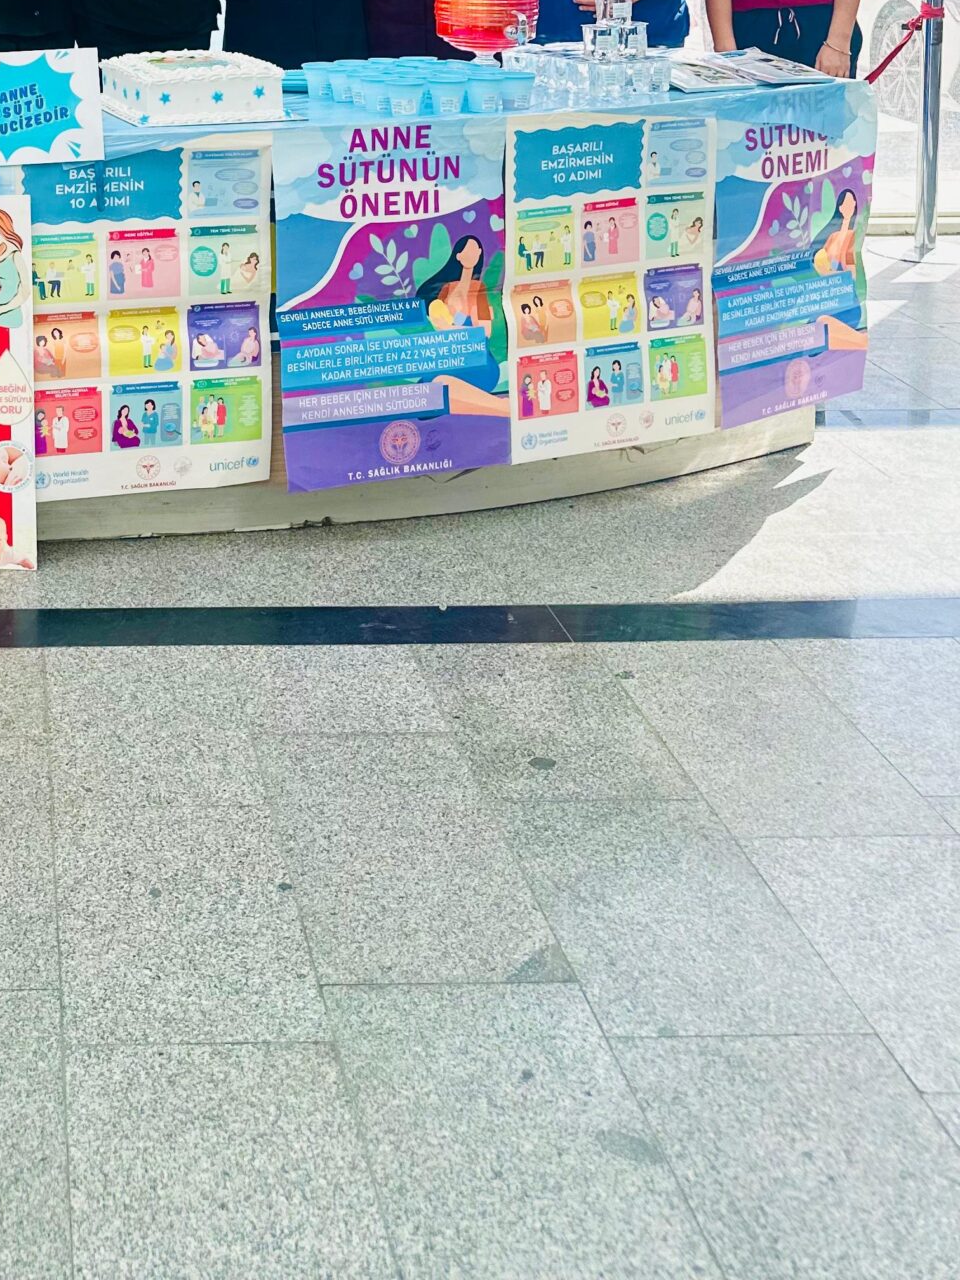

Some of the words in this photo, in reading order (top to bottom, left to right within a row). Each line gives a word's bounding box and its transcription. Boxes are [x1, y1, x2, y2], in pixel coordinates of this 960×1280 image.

[0, 84, 37, 104] ANNE
[3, 94, 44, 118] SÜTÜ
[349, 125, 432, 153] ANNE
[745, 122, 834, 151] SÜTÜN
[552, 141, 603, 155] BAŞARILI
[317, 151, 460, 189] SÜTÜNÜN
[541, 154, 613, 171] EMZİRMENİN
[761, 144, 828, 179] ÖNEMİ
[69, 167, 131, 180] BAŞRILI
[553, 173, 565, 183] 10
[569, 169, 602, 181] ADIMI
[70, 198, 85, 208] 10
[340, 183, 440, 219] ÖNEMİ
[5, 395, 32, 403] SÜTÜYLE
[665, 413, 692, 425] unicef
[210, 458, 245, 472] unicef
[348, 472, 365, 480] T.C.
[368, 466, 400, 477] SAĞLIK
[404, 460, 452, 473] BAKANLIĞI
